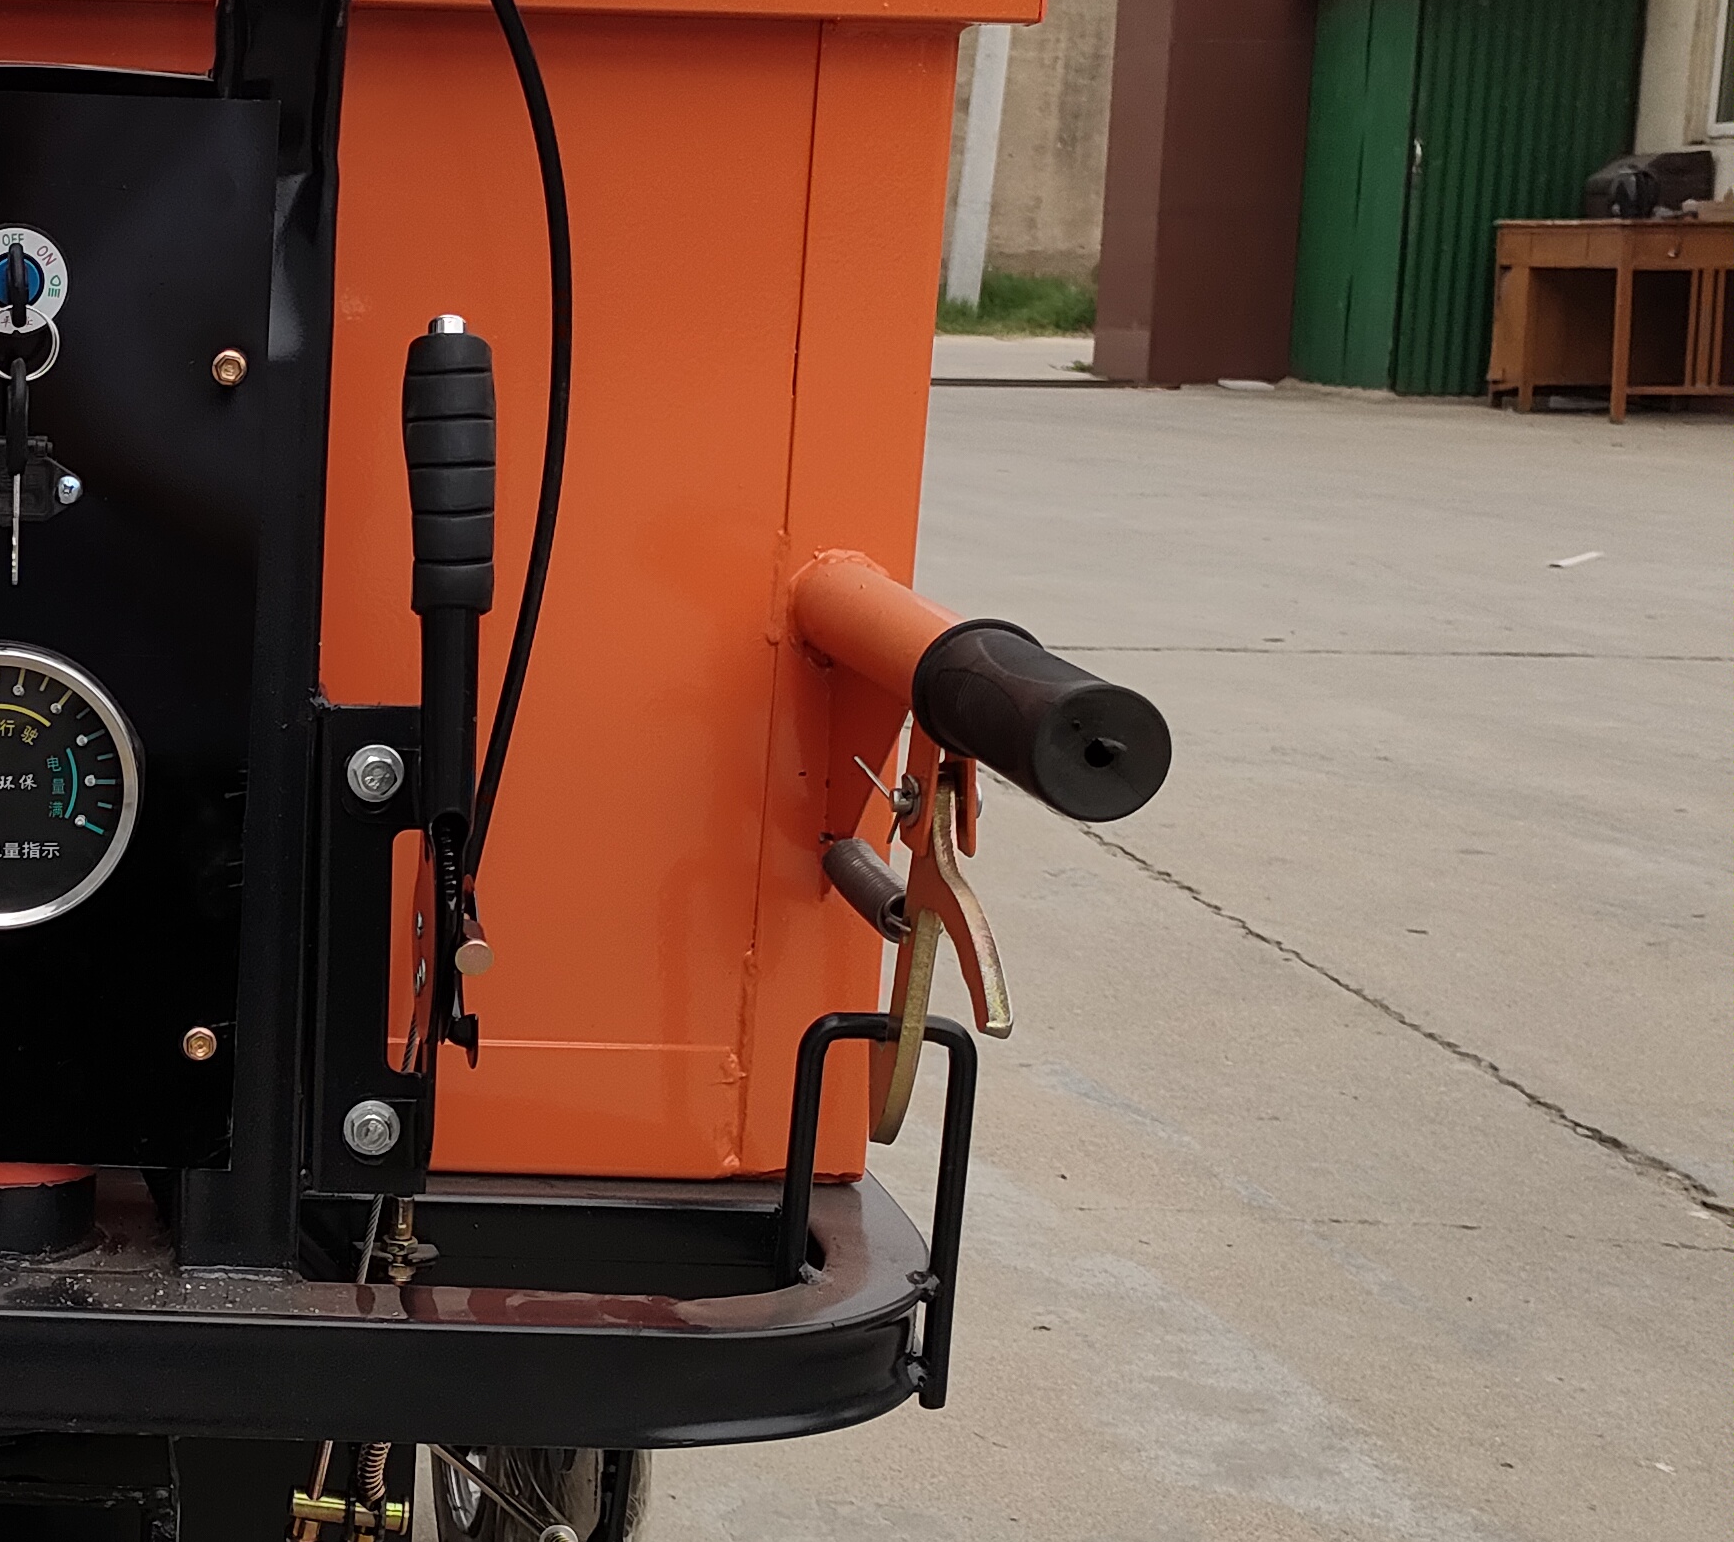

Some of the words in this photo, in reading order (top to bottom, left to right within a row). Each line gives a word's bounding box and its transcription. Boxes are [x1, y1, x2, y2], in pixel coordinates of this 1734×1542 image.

[2, 233, 25, 246] OFF
[36, 245, 58, 267] ON
[46, 755, 66, 819] 电量满
